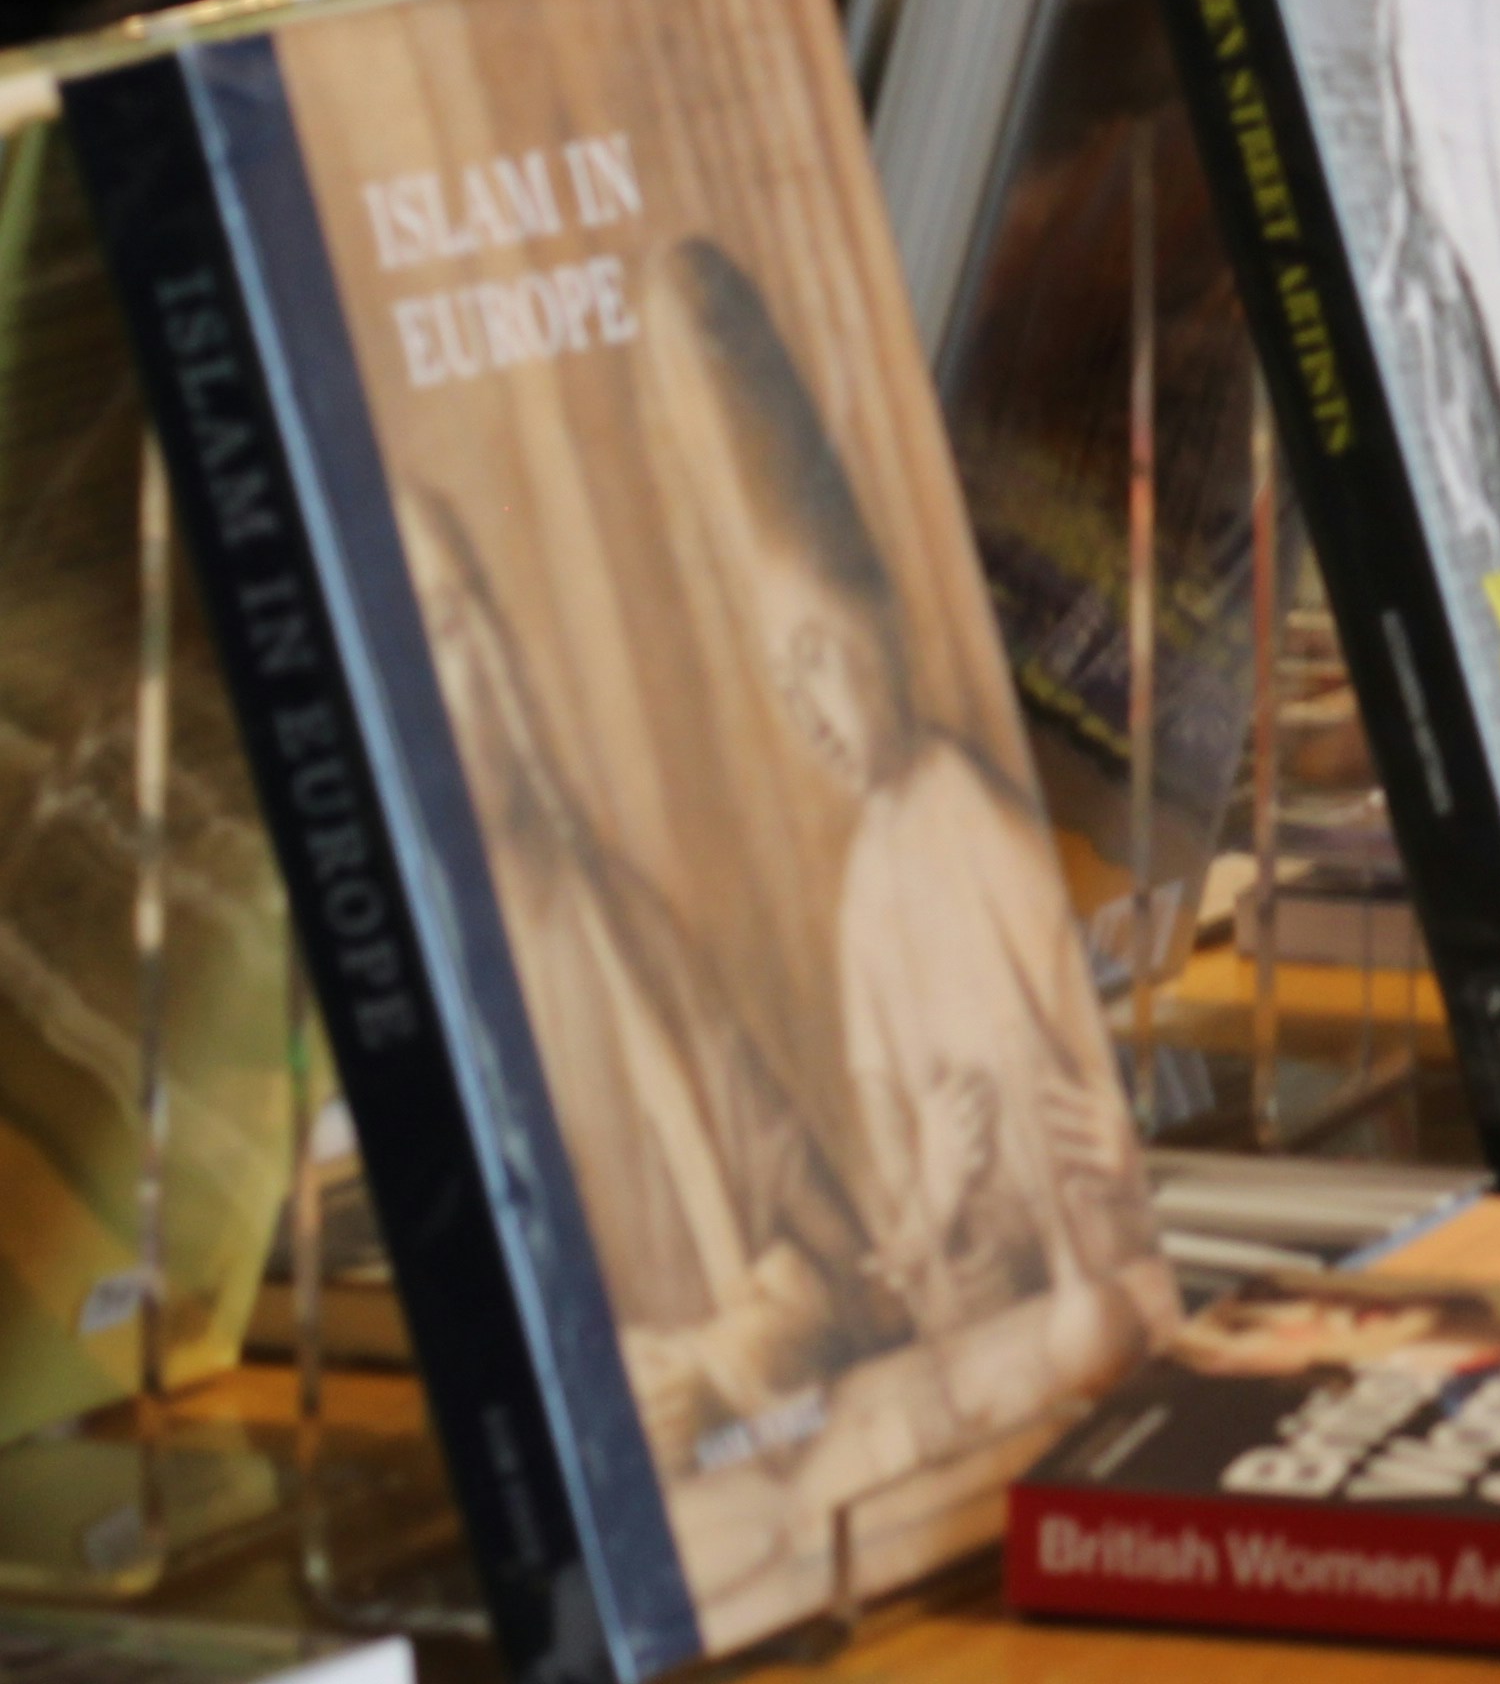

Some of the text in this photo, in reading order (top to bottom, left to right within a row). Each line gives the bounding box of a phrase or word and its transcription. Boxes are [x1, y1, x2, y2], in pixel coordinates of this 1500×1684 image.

[360, 129, 645, 271] ISLAM IN
[1224, 66, 1304, 245] STREET
[1275, 262, 1355, 459] ARTISTS
[391, 252, 638, 389] EUROPE
[155, 266, 420, 1054] ISLAM IN EUROPE
[1036, 1514, 1217, 1586] British
[1226, 1531, 1440, 1603] Women
